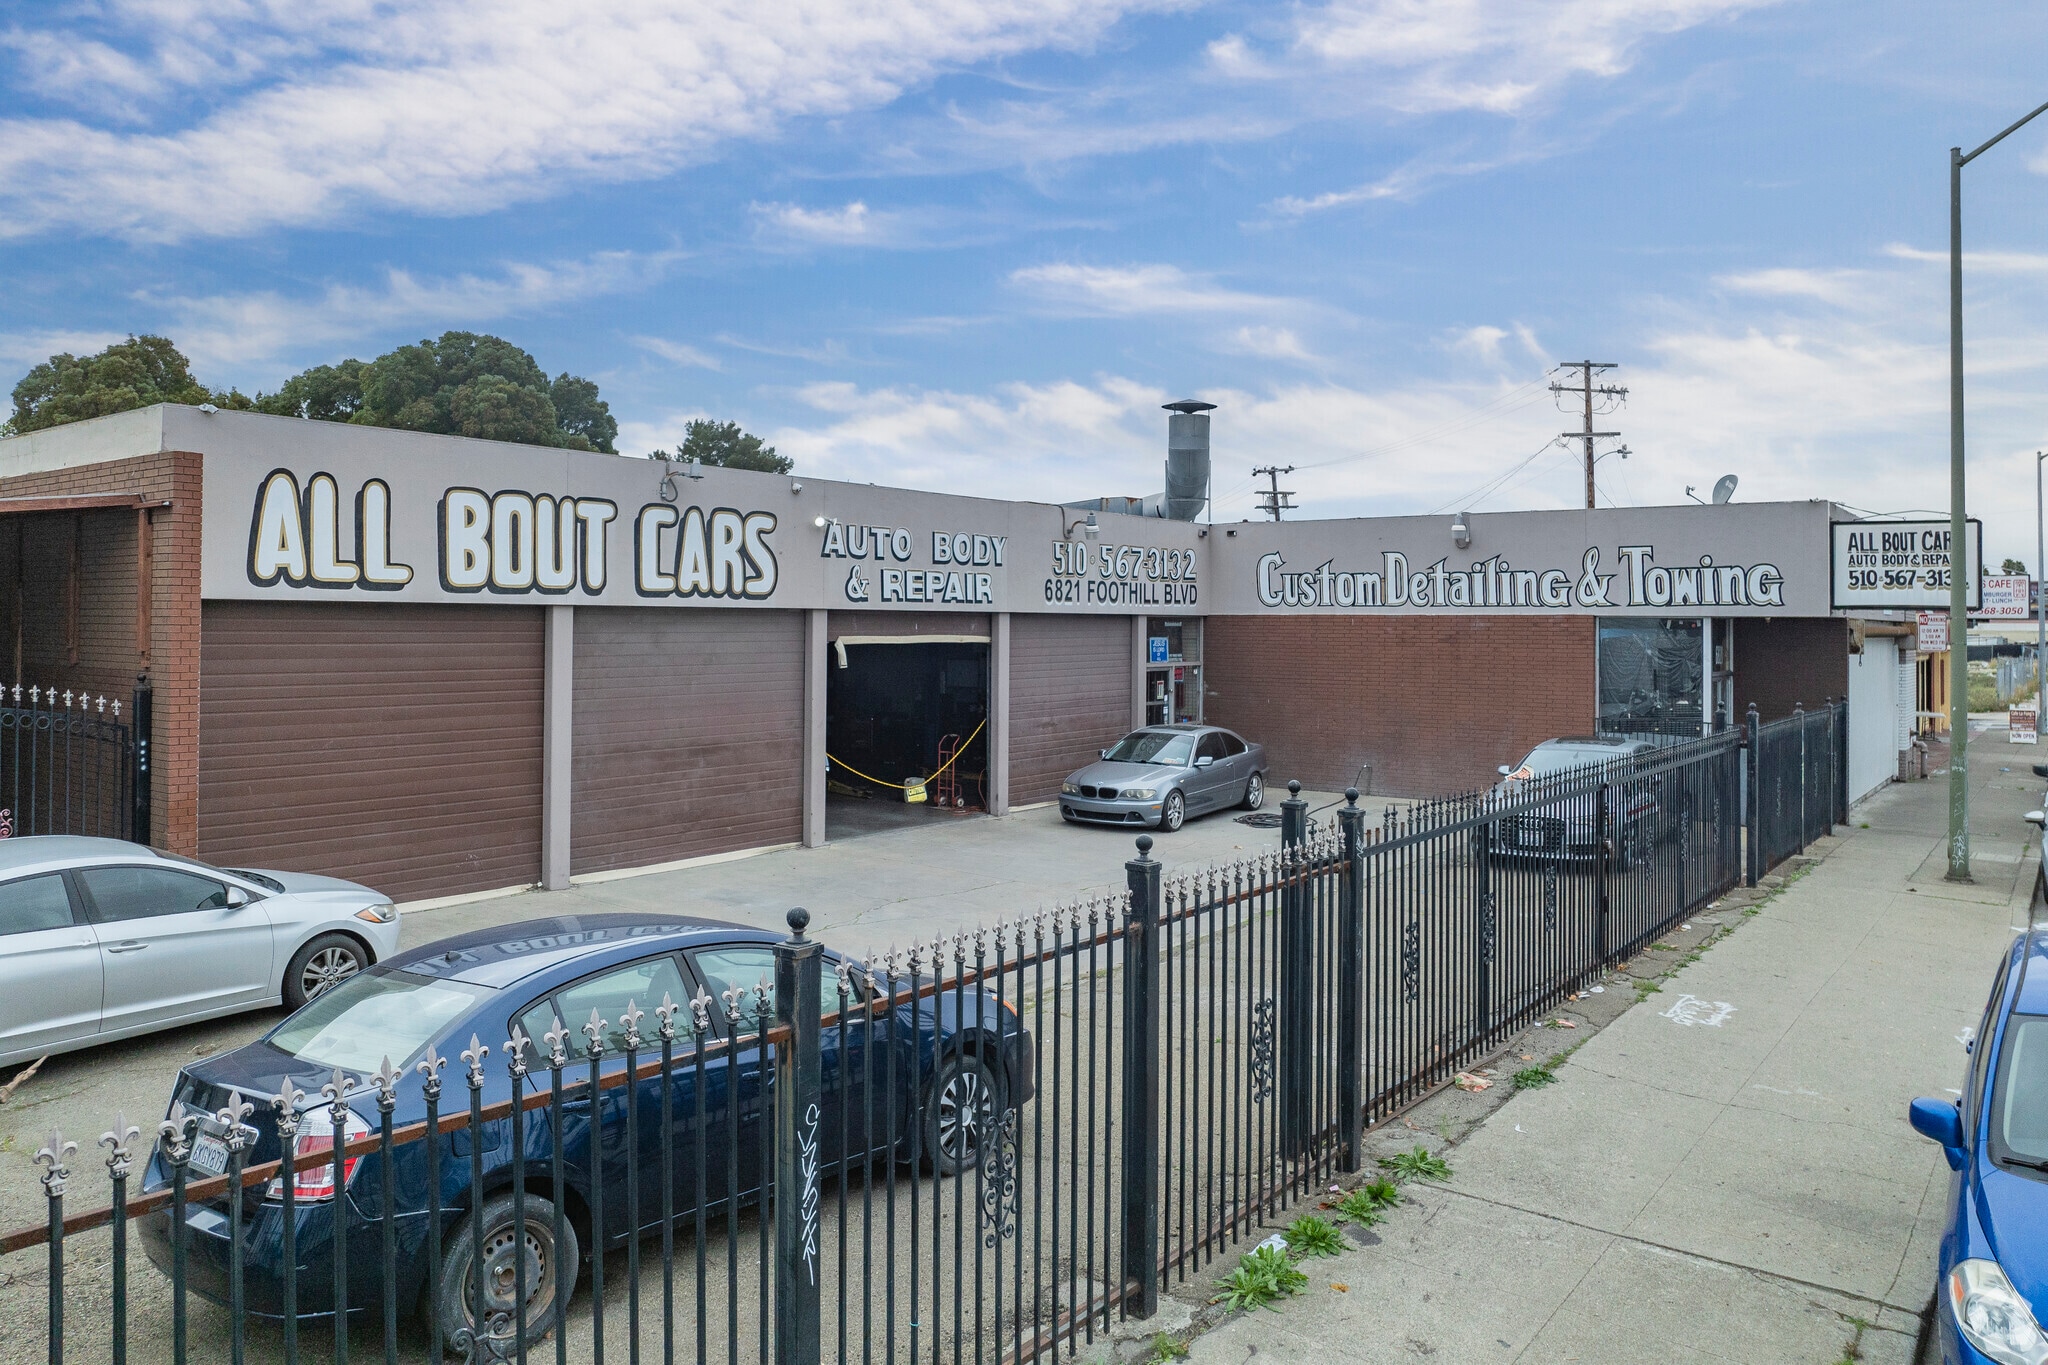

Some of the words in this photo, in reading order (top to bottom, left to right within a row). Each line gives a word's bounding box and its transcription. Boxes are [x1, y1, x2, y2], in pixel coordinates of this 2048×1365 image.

[247, 468, 413, 591] ALL
[438, 486, 617, 596] BOUT
[635, 503, 778, 600] CARS
[821, 522, 913, 562] AUTO
[932, 531, 1007, 567] BODY
[1848, 532, 1879, 552] ALL
[1882, 532, 1917, 552] BOUT
[1922, 530, 1951, 552] CAR
[1099, 544, 1197, 583] 567-3132
[1848, 554, 1877, 566] AUTO
[1882, 554, 1910, 566] BODY
[1911, 553, 1920, 566] &
[1922, 554, 1951, 566] REPA
[845, 564, 869, 602] &
[880, 567, 993, 604] REPAIR
[1256, 551, 1382, 607] Custom
[1575, 546, 1620, 607] &
[1849, 570, 1877, 587] 510
[1884, 570, 1968, 587] 567-313
[1989, 580, 2011, 588] CAFE
[1045, 578, 1080, 603] 6821
[1088, 581, 1159, 605] FOOTHILL
[1164, 583, 1198, 606] BLVD
[1920, 615, 1928, 624] NO
